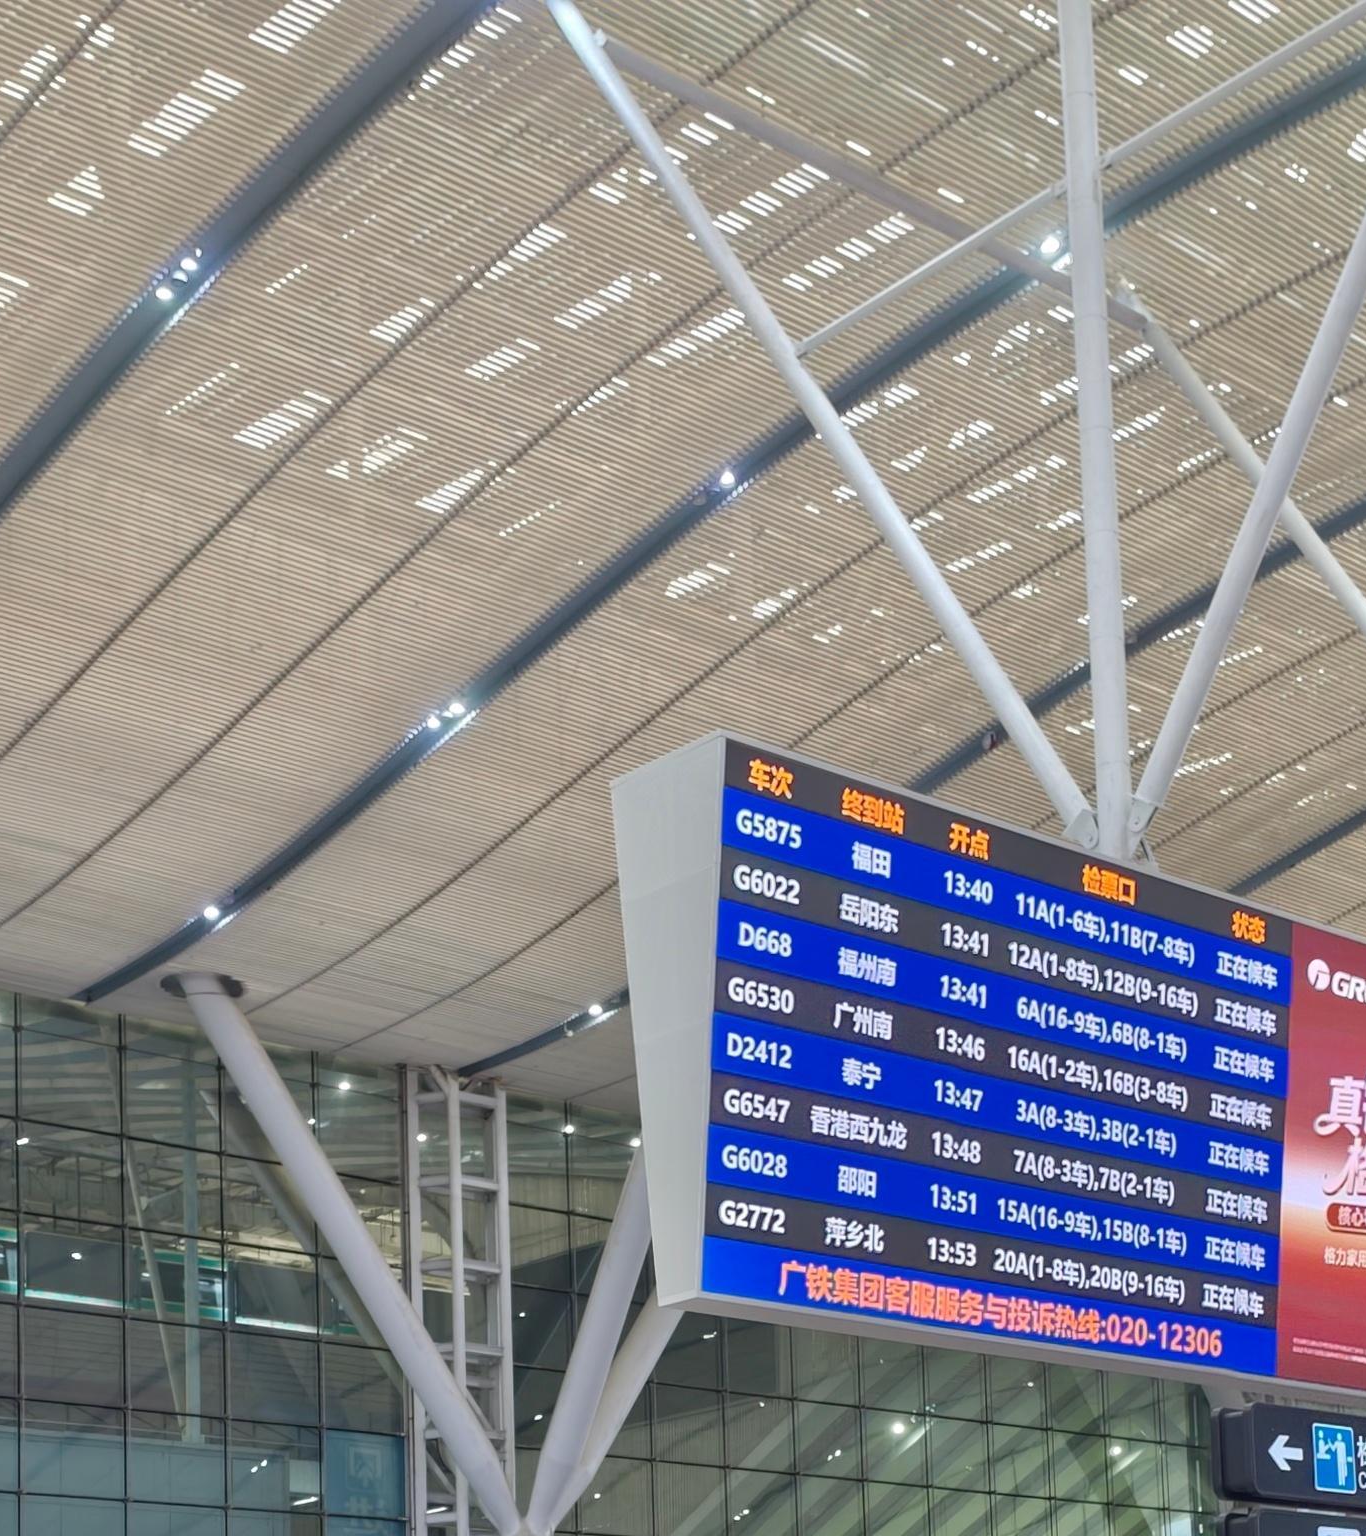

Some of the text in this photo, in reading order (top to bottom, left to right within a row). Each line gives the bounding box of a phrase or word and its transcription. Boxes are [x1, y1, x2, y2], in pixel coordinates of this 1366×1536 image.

[736, 809, 1278, 990] G5875 福田 13:40 11A(1-6车),11B(7-8车) 正在候车
[748, 758, 1266, 944] 车次 终到站 开点 检票口 状态
[733, 864, 1277, 1037] G6022 岳阳东 13:41 12A(1-8车),12B(9-16车) 正在候车
[738, 922, 1275, 1082] D668 福州南 13:41 6A(16-9车),6B(8-1车) 正在候车
[726, 1032, 1270, 1176] D2412 泰宁 13:47 3A(8-3车),3B(2-1车) 正在候车
[727, 977, 1272, 1131] G6530 广州南 13:46 16A(1-2车),16B(3-8车) 正在候车
[722, 1144, 1266, 1271] G6028 邵阳 13:51 15A(16-9车),15B(8-1车) 正在候车
[724, 1088, 1268, 1225] G6547 香港西九龙 13:48 7A(8-3车),7B(2-1车) 正在候车
[719, 1200, 1264, 1319] G2772 萍乡北 13:53 20A(1-8车),20B(9-16车) 正在候车
[778, 1260, 1222, 1357] 广铁集团客服服务与投诉热线:020-12306
